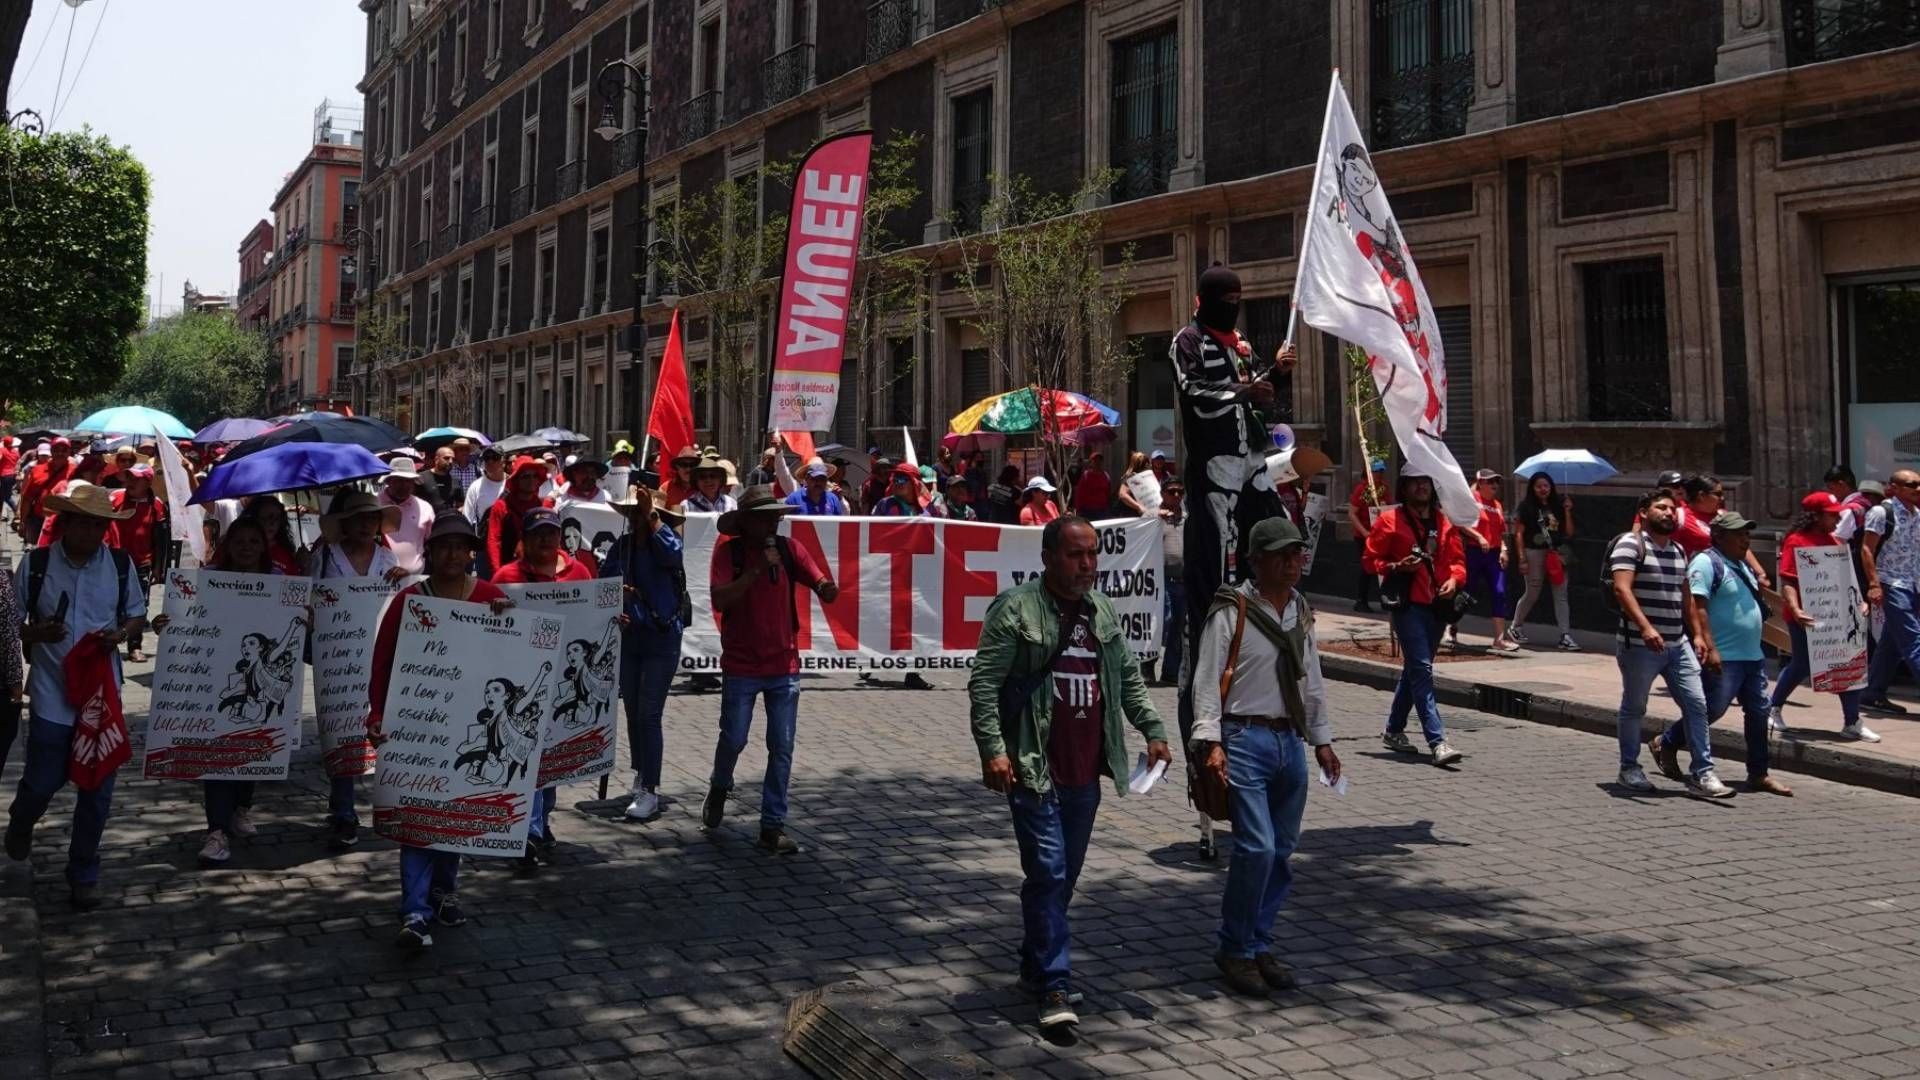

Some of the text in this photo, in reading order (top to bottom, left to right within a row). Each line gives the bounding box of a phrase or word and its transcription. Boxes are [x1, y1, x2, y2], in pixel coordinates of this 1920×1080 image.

[208, 578, 265, 592] Sección 9
[710, 520, 1001, 651] NTE
[525, 588, 580, 601] Sección 9
[186, 605, 209, 618] Me
[332, 610, 352, 623] Me
[450, 609, 515, 629] Sección 9
[166, 625, 222, 640] enseñaste
[404, 622, 435, 634] CNTE
[533, 631, 560, 647] 2024
[168, 646, 176, 654] a
[207, 647, 215, 658] y
[423, 640, 448, 657] Me
[870, 657, 907, 669] LOS
[914, 656, 976, 669] DEREC
[400, 662, 463, 681] enseñaste
[160, 679, 213, 694] ahora me
[320, 683, 367, 696] ahora me
[400, 686, 410, 696] a
[444, 692, 454, 703] y
[156, 700, 213, 713] enseñas a
[398, 706, 449, 726] escribir,
[153, 715, 216, 733] LUCHAR.
[389, 729, 449, 748] ahora me
[384, 750, 435, 768] enseñas
[439, 760, 449, 769] a
[380, 768, 449, 793] LUCHAR.
